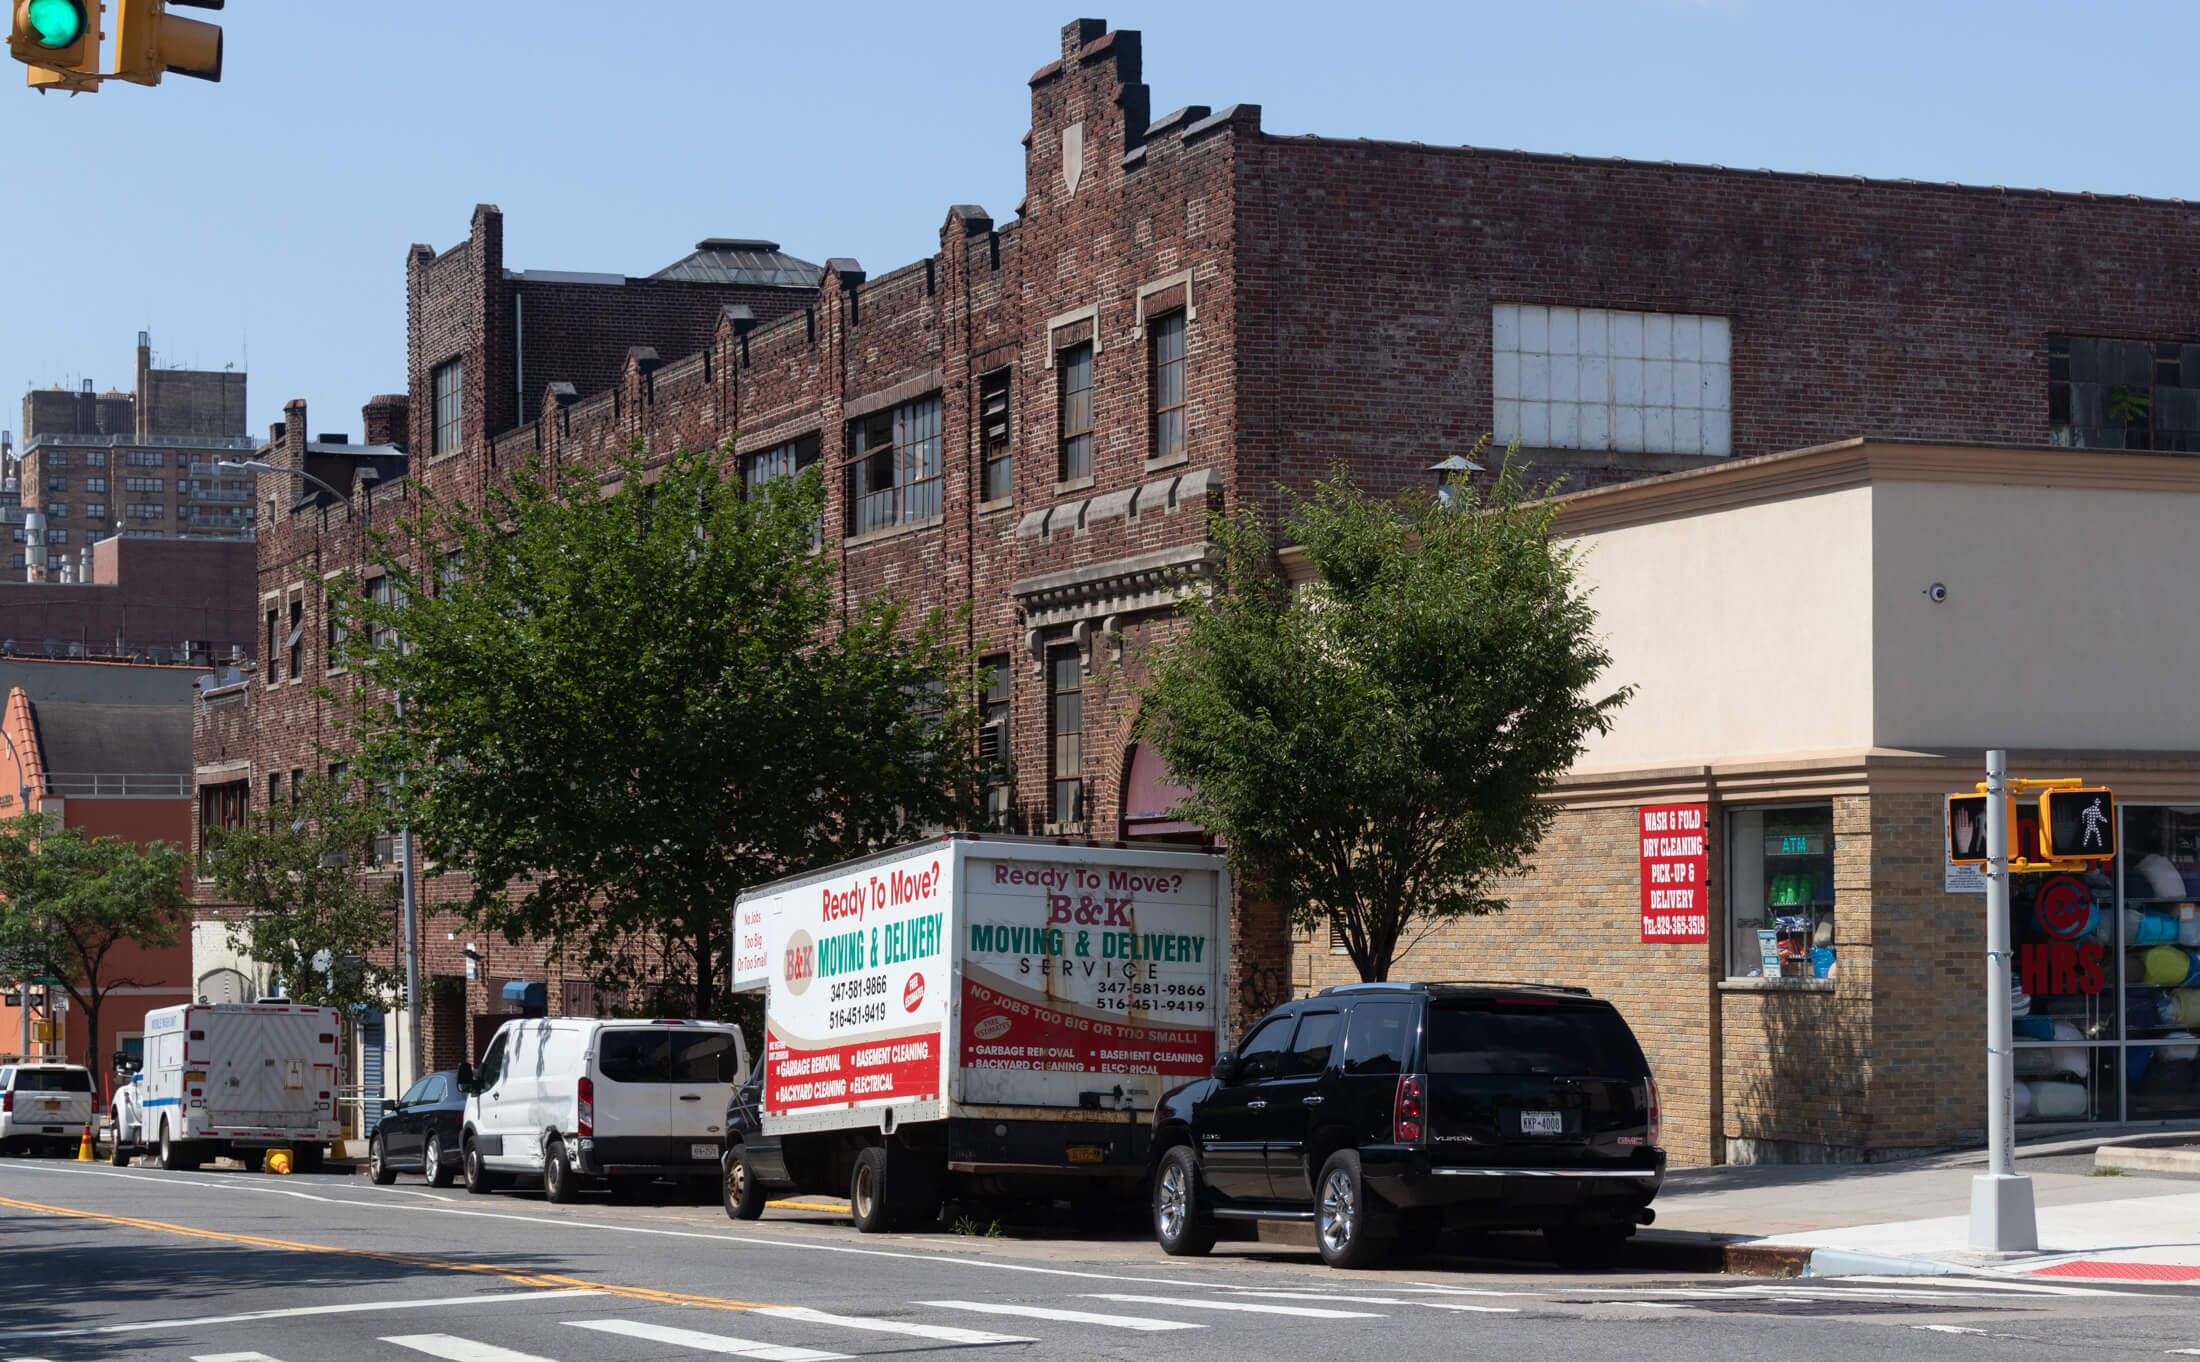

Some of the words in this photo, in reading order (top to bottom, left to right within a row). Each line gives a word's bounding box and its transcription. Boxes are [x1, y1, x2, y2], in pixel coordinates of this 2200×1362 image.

[1644, 812, 1668, 831] WASH
[1670, 811, 1676, 830] &
[1678, 810, 1700, 830] FOLD
[1644, 838, 1659, 857] DRY
[1660, 836, 1702, 856] CLEANING
[1783, 836, 1806, 853] ATM
[995, 864, 1069, 892] Ready
[1075, 869, 1101, 890] To
[1108, 872, 1182, 894] Move?
[1652, 864, 1686, 883] PICK-UP
[1688, 863, 1695, 882] &
[823, 881, 866, 922] Ready
[870, 876, 886, 911] To
[890, 860, 940, 907] Move?
[1650, 890, 1694, 909] DELIVERY
[1048, 894, 1133, 927] B&K
[2055, 899, 2076, 917] 24
[818, 930, 864, 978] MOVING
[870, 927, 878, 968] &
[884, 912, 943, 965] DELIVERY
[971, 924, 1064, 956] MOVING
[1075, 930, 1090, 958] &
[1103, 932, 1205, 963] DELIVERY
[785, 945, 813, 982] B&K
[1020, 958, 1158, 980] SERVICE
[2023, 943, 2103, 994] HRS
[830, 974, 887, 1002] 347-581-9866
[1097, 982, 1206, 996] 347-581-9866
[830, 1002, 886, 1030] 516-451-9419
[970, 984, 991, 1001] NO
[993, 996, 1030, 1016] JOBS
[1033, 1007, 1062, 1025] TOO
[1064, 1016, 1089, 1032] BIG
[1093, 1022, 1113, 1036] OR
[1116, 1026, 1144, 1041] TOO
[1149, 1030, 1198, 1044] SMALL!
[1096, 998, 1205, 1012] 516-451-9419
[856, 1046, 891, 1068] BASEMENT
[892, 1042, 928, 1063] CLEANING
[976, 1045, 1024, 1057] GARBAGE
[1153, 1051, 1204, 1064] CLEANING
[780, 1058, 810, 1078] GARBAGE
[811, 1054, 840, 1074] REMOVAL
[976, 1058, 1030, 1070] BACKYARD
[780, 1082, 813, 1102] BACKYARD
[814, 1079, 847, 1099] CLEANING
[854, 1073, 894, 1094] ELECTRICAL
[1617, 1136, 1643, 1144] GMC
